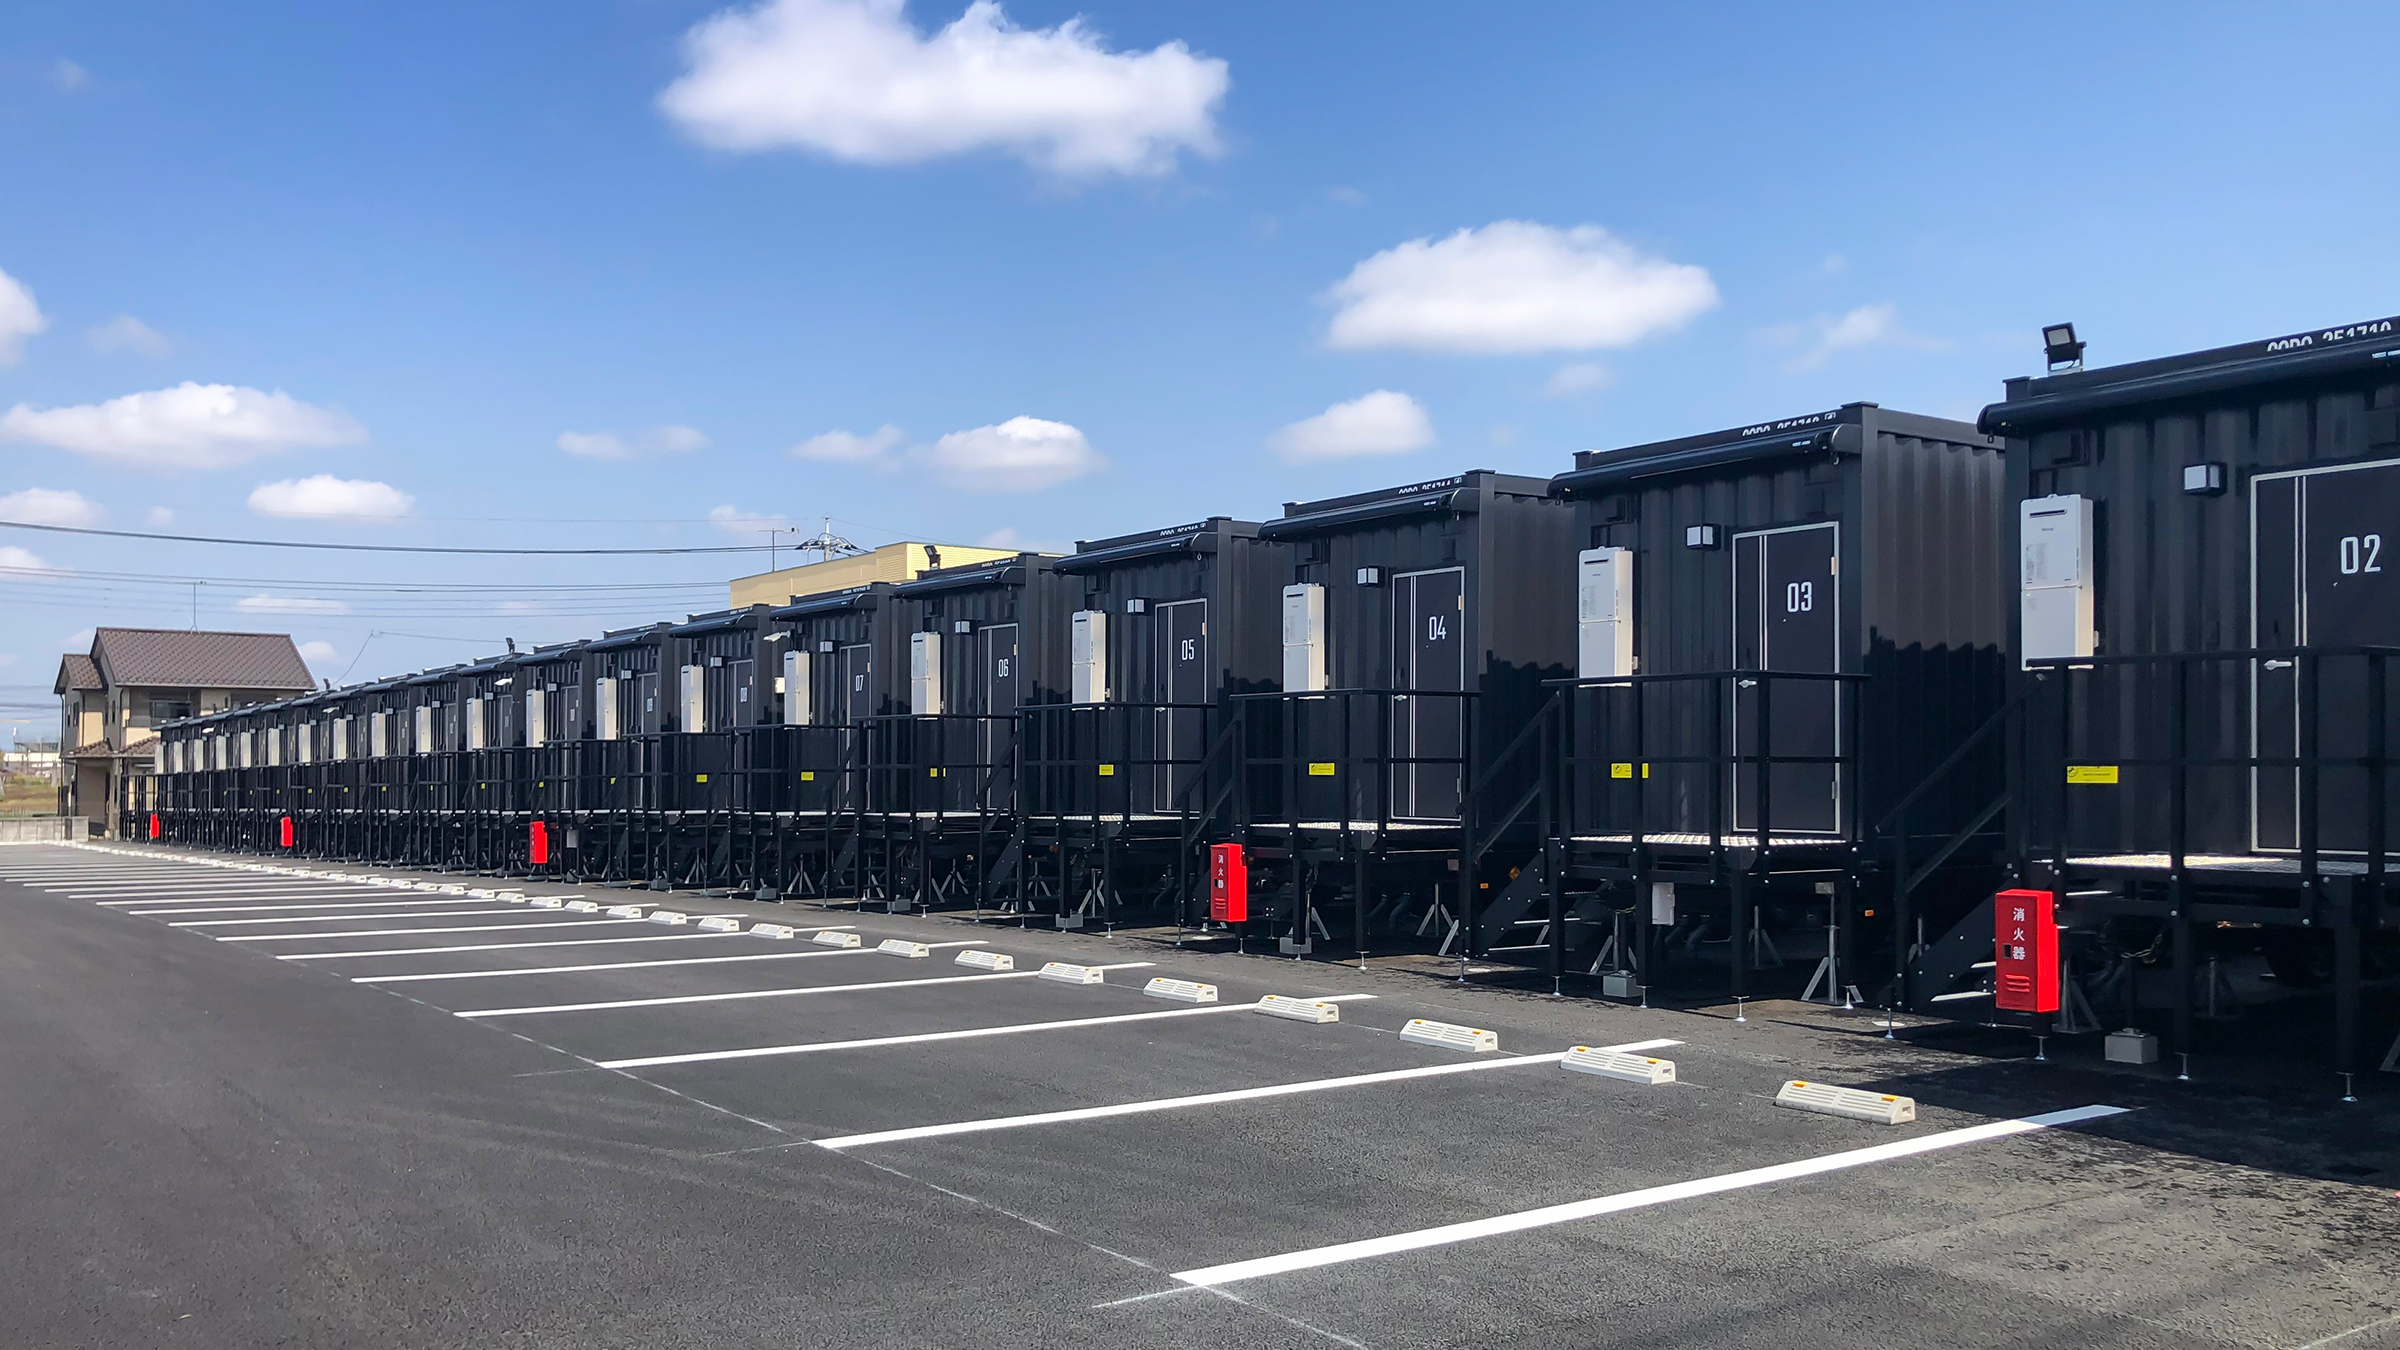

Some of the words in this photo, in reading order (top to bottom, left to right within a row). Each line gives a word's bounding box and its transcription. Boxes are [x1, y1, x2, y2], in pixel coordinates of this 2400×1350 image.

[2340, 535, 2381, 574] 02
[1787, 582, 1812, 613] 03
[1429, 615, 1446, 641] 04
[1181, 639, 1195, 661] 05
[998, 658, 1009, 678] 06
[855, 674, 864, 692] 07
[2012, 907, 2026, 961] 消火器
